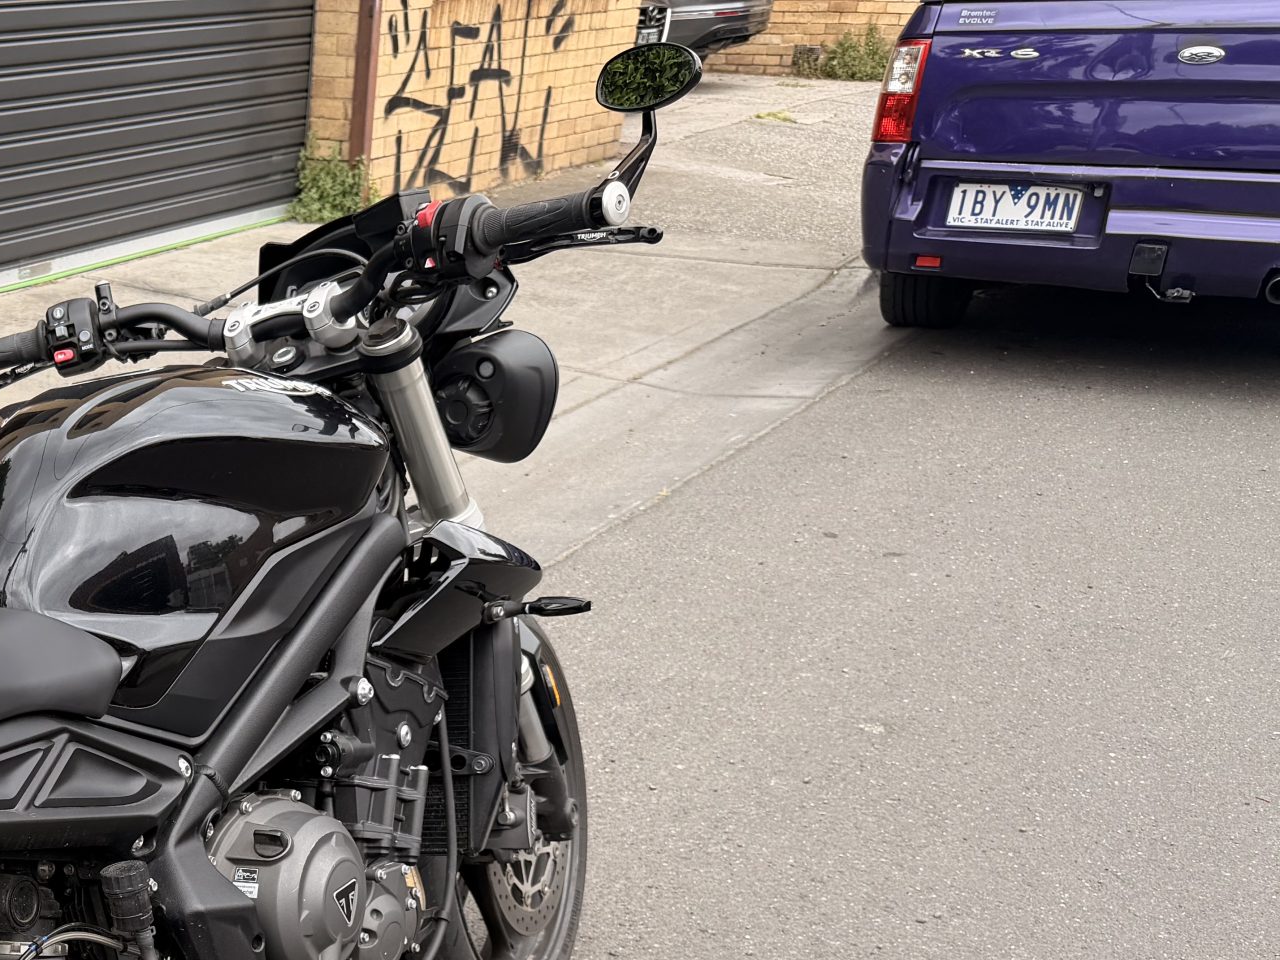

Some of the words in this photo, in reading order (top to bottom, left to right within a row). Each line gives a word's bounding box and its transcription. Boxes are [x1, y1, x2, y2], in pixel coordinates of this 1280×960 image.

[1010, 48, 1040, 58] 6
[958, 189, 1006, 217] 1BY
[1023, 191, 1078, 221] 9MN
[994, 218, 1021, 226] ALERT
[1023, 219, 1046, 227] STAY
[1045, 220, 1071, 229] ALIVE
